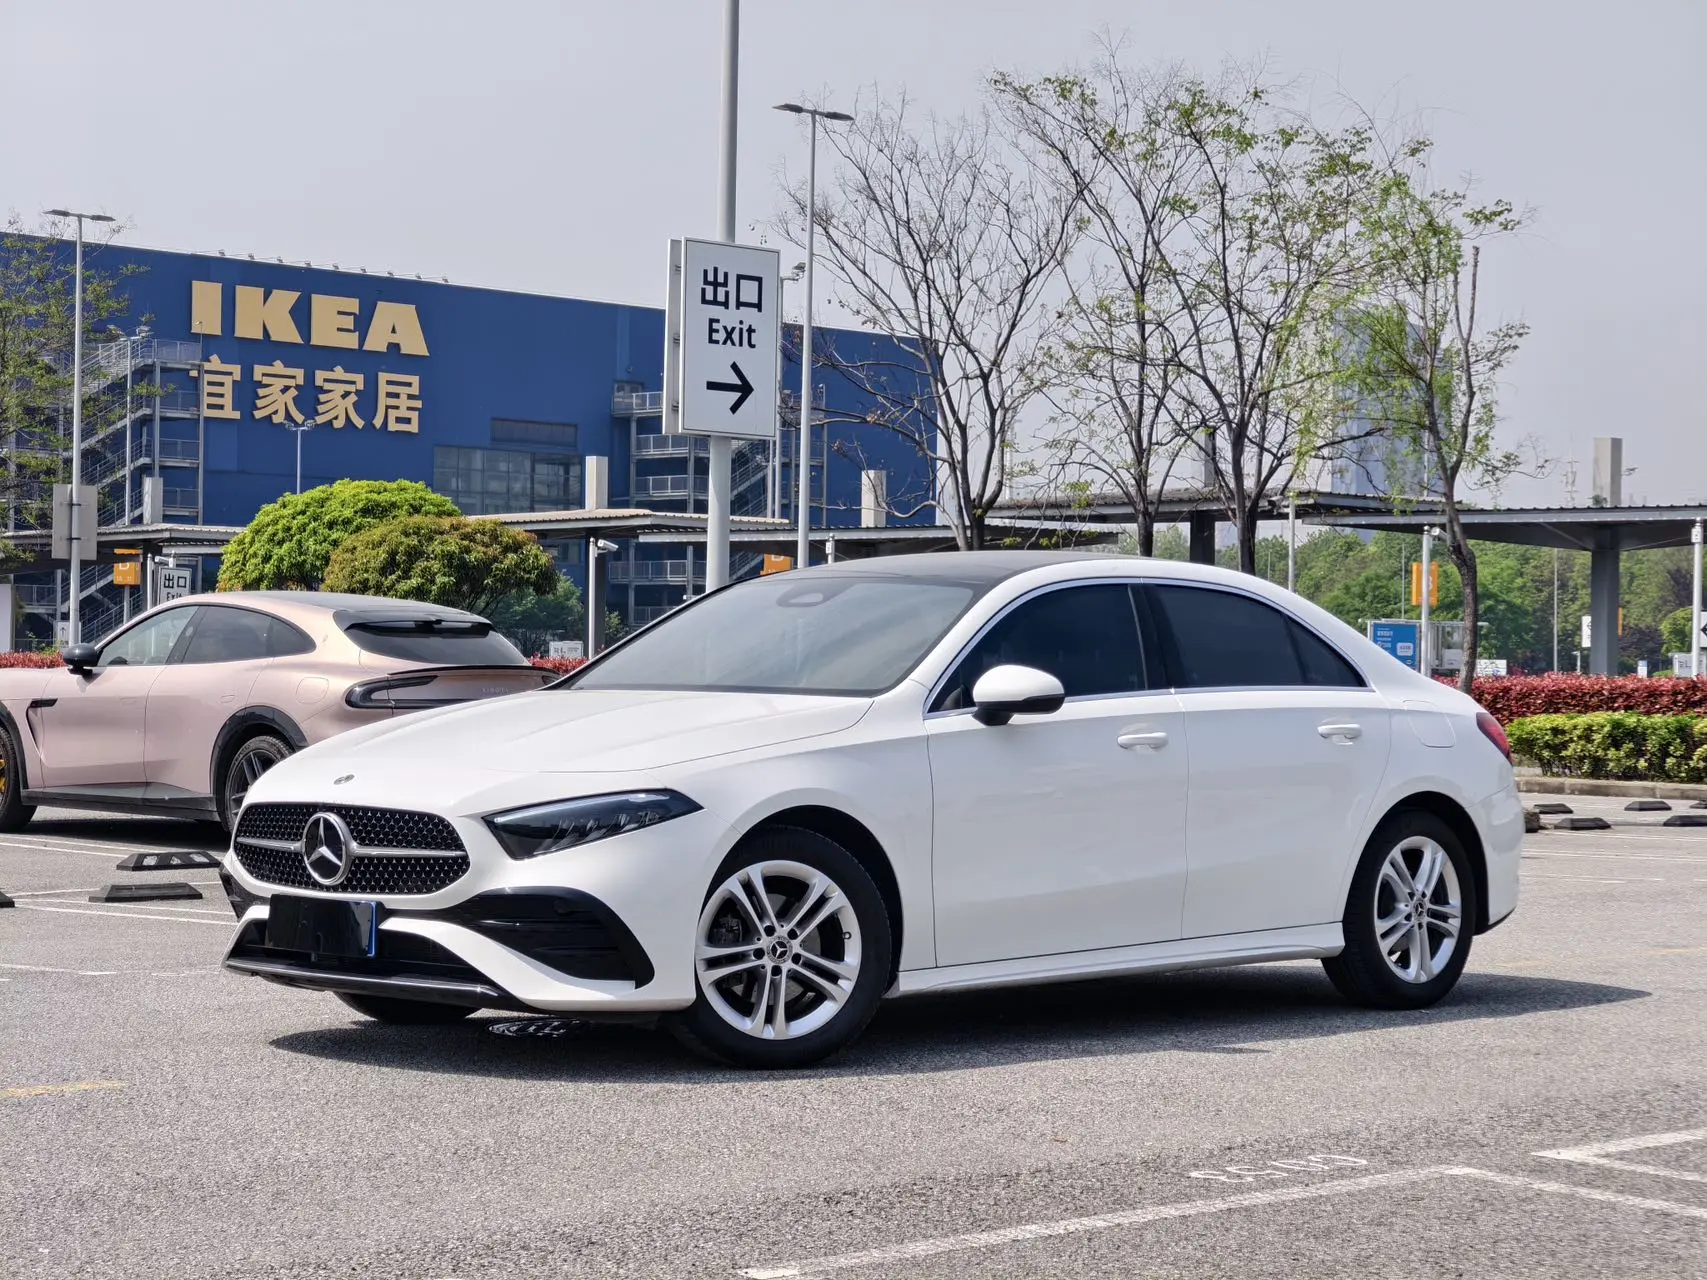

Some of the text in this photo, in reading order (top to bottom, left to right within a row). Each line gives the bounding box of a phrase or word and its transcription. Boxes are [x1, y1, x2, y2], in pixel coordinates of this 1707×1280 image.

[701, 266, 763, 313] 出口
[191, 280, 430, 356] IKEA
[708, 317, 756, 349] Exit
[189, 354, 422, 434] 宜家家居
[163, 573, 187, 589] 出口
